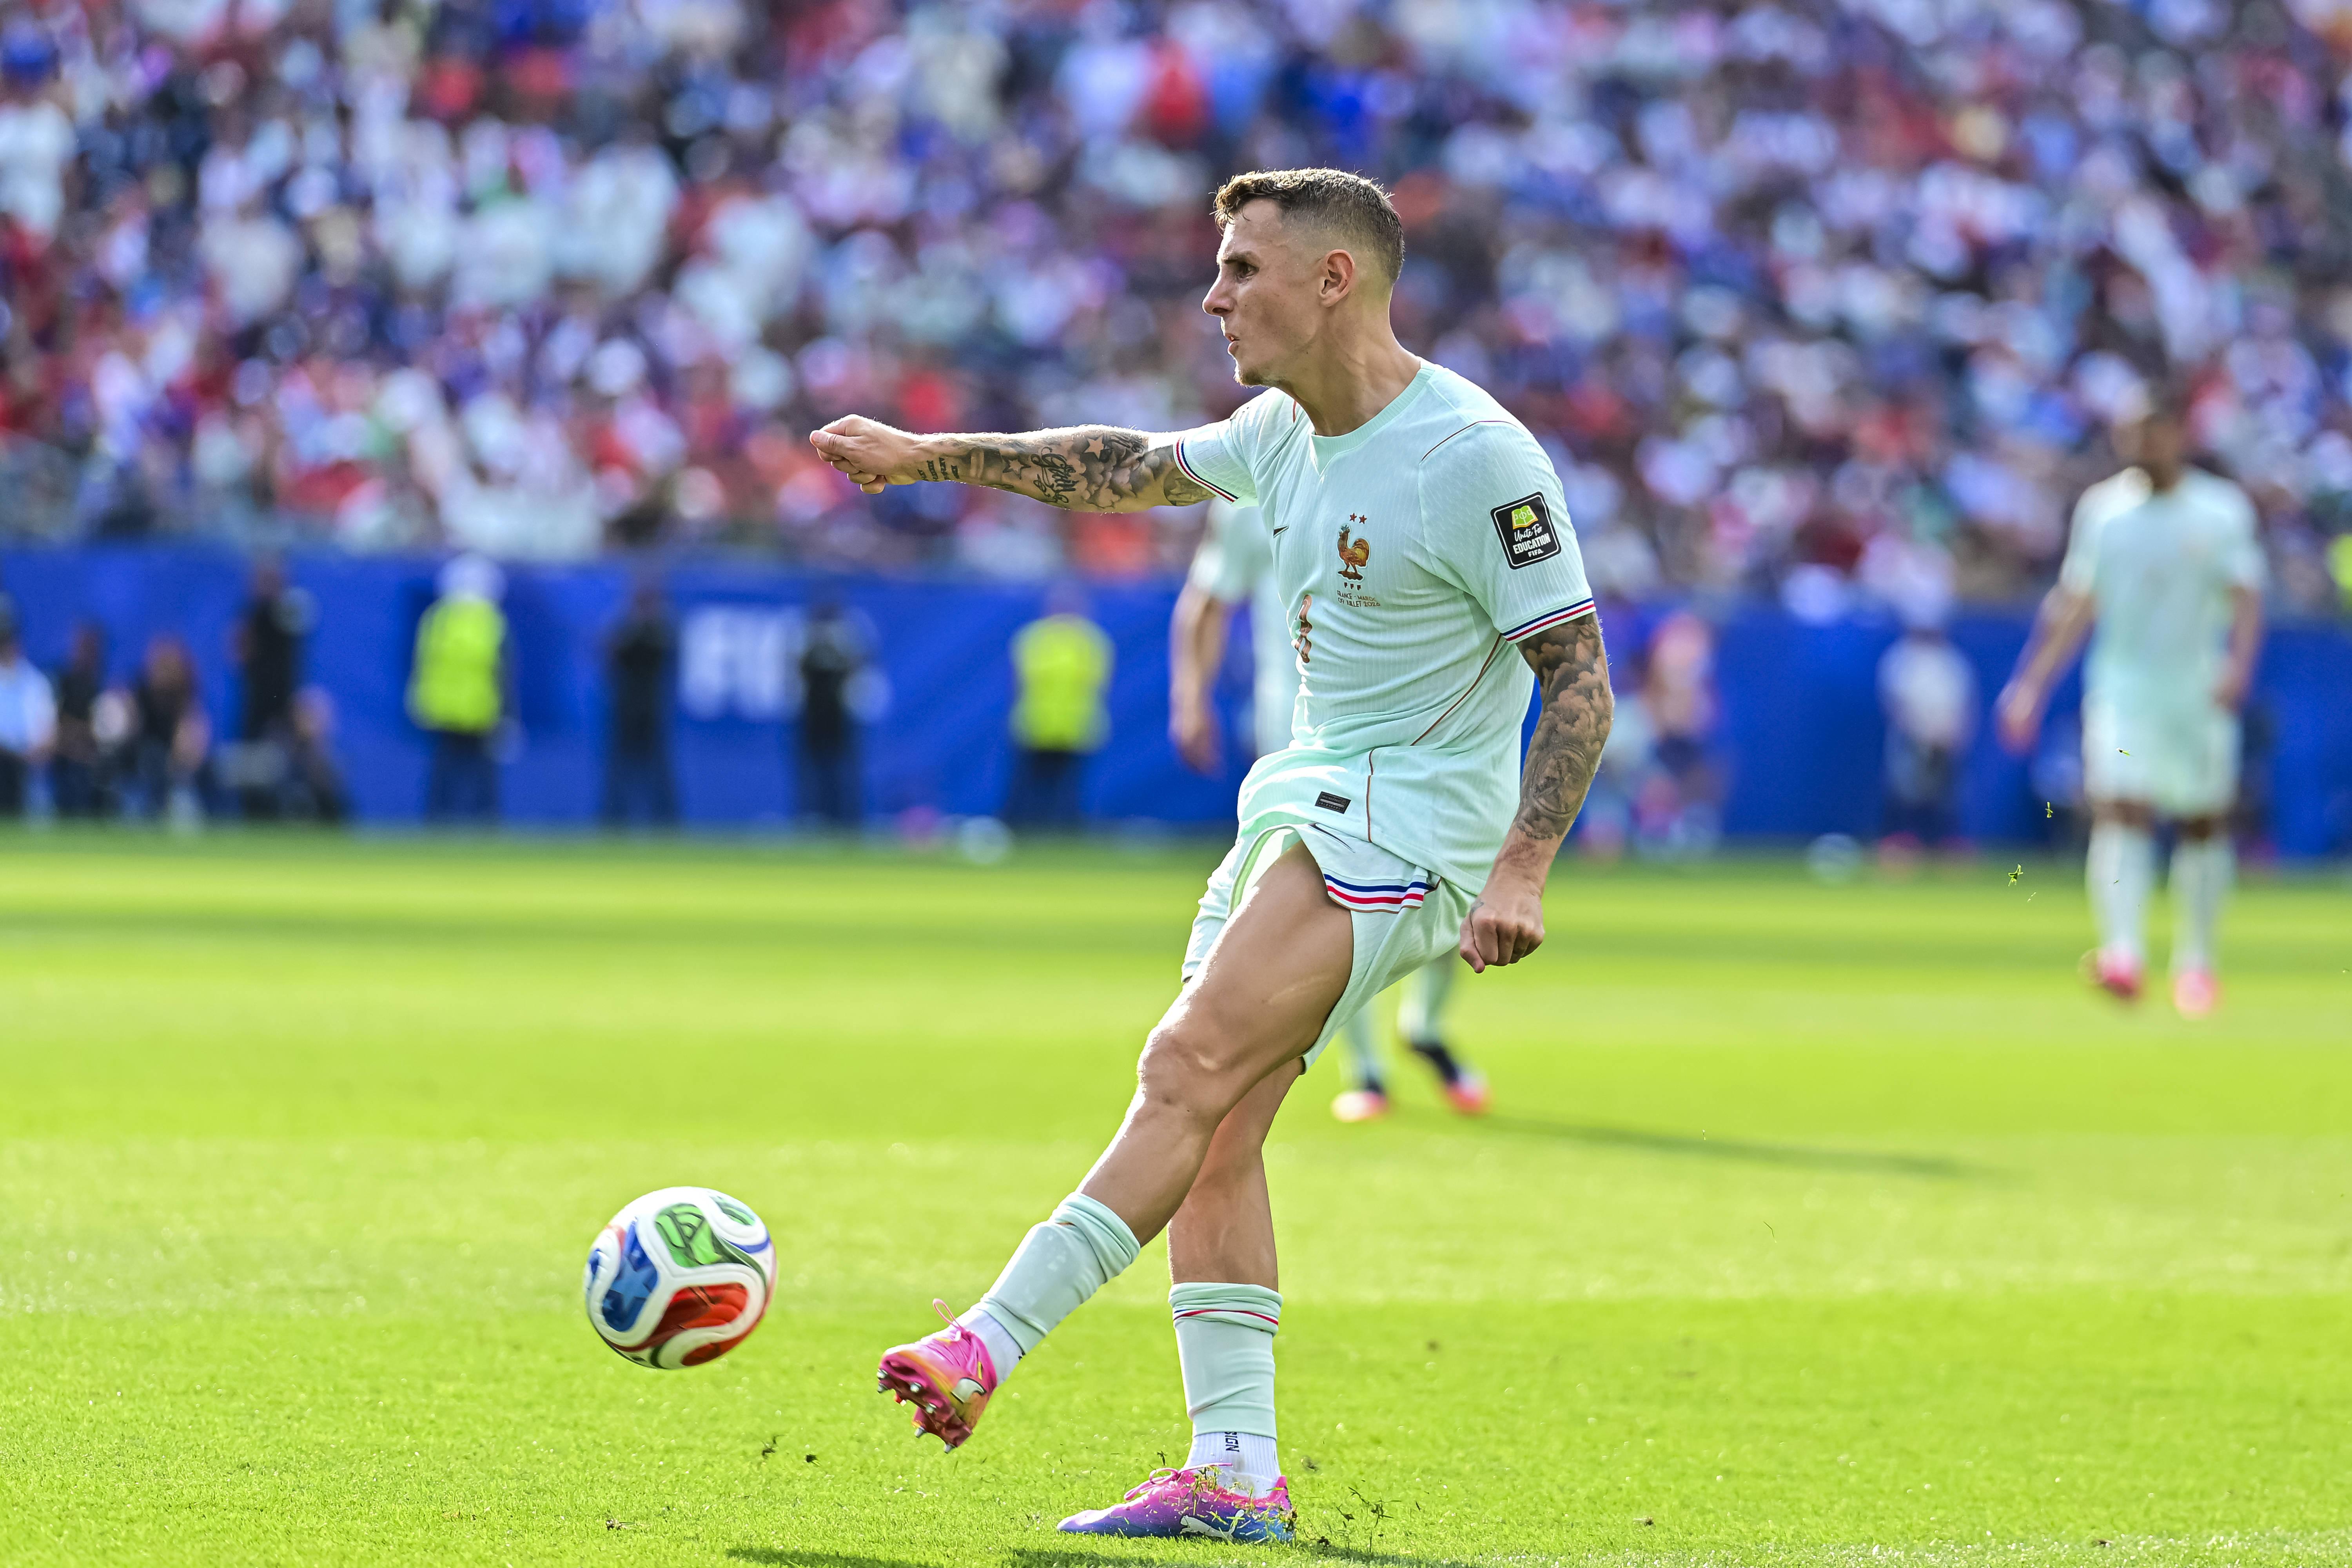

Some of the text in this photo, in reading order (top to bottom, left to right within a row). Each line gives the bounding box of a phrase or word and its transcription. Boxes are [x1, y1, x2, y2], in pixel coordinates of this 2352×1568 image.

[1514, 524, 1543, 542] Unite For
[1513, 533, 1551, 554] EDUCATION
[1528, 549, 1544, 557] FIFA
[1337, 590, 1352, 600] FRANCE
